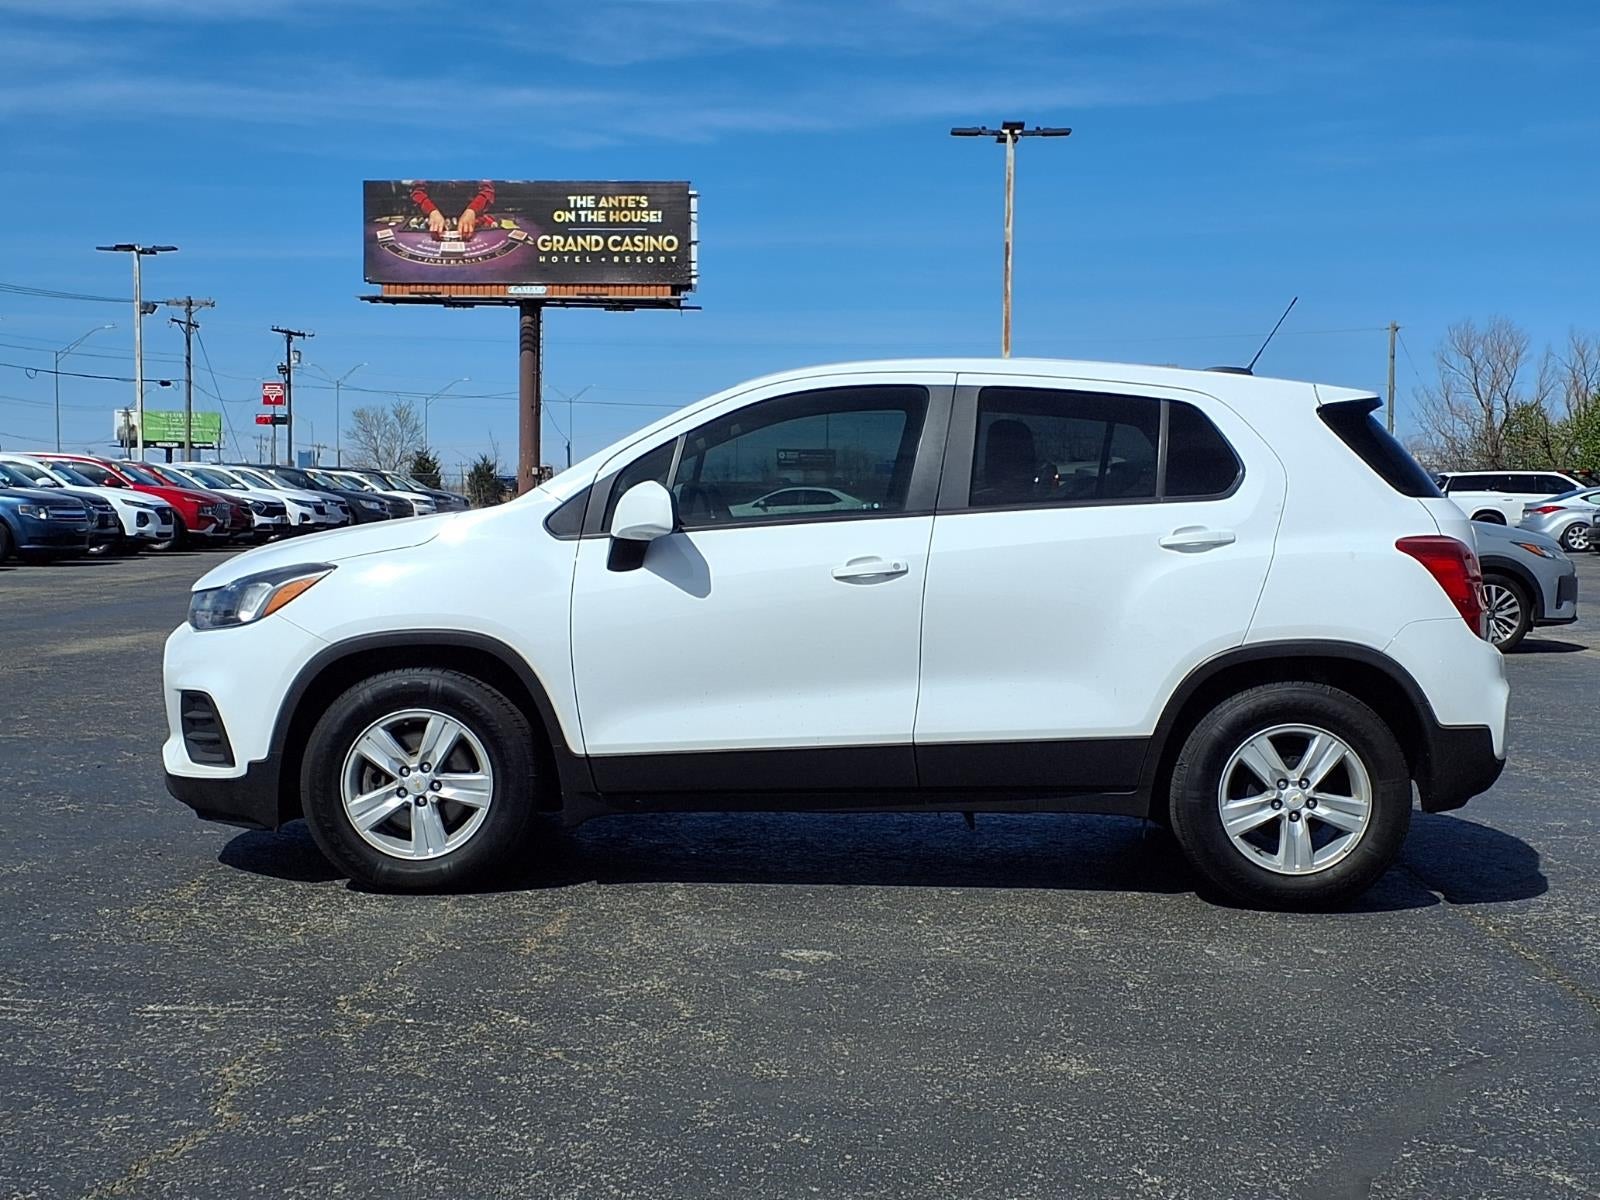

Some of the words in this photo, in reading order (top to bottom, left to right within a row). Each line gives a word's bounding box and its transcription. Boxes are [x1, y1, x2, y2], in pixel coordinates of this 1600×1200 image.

[568, 196, 595, 208] THE
[598, 196, 648, 208] ANTE'S
[553, 211, 576, 223] ON
[578, 211, 606, 223] THE
[609, 210, 662, 223] HOUSE!
[537, 235, 604, 252] GRAND
[607, 235, 679, 252] CASINO
